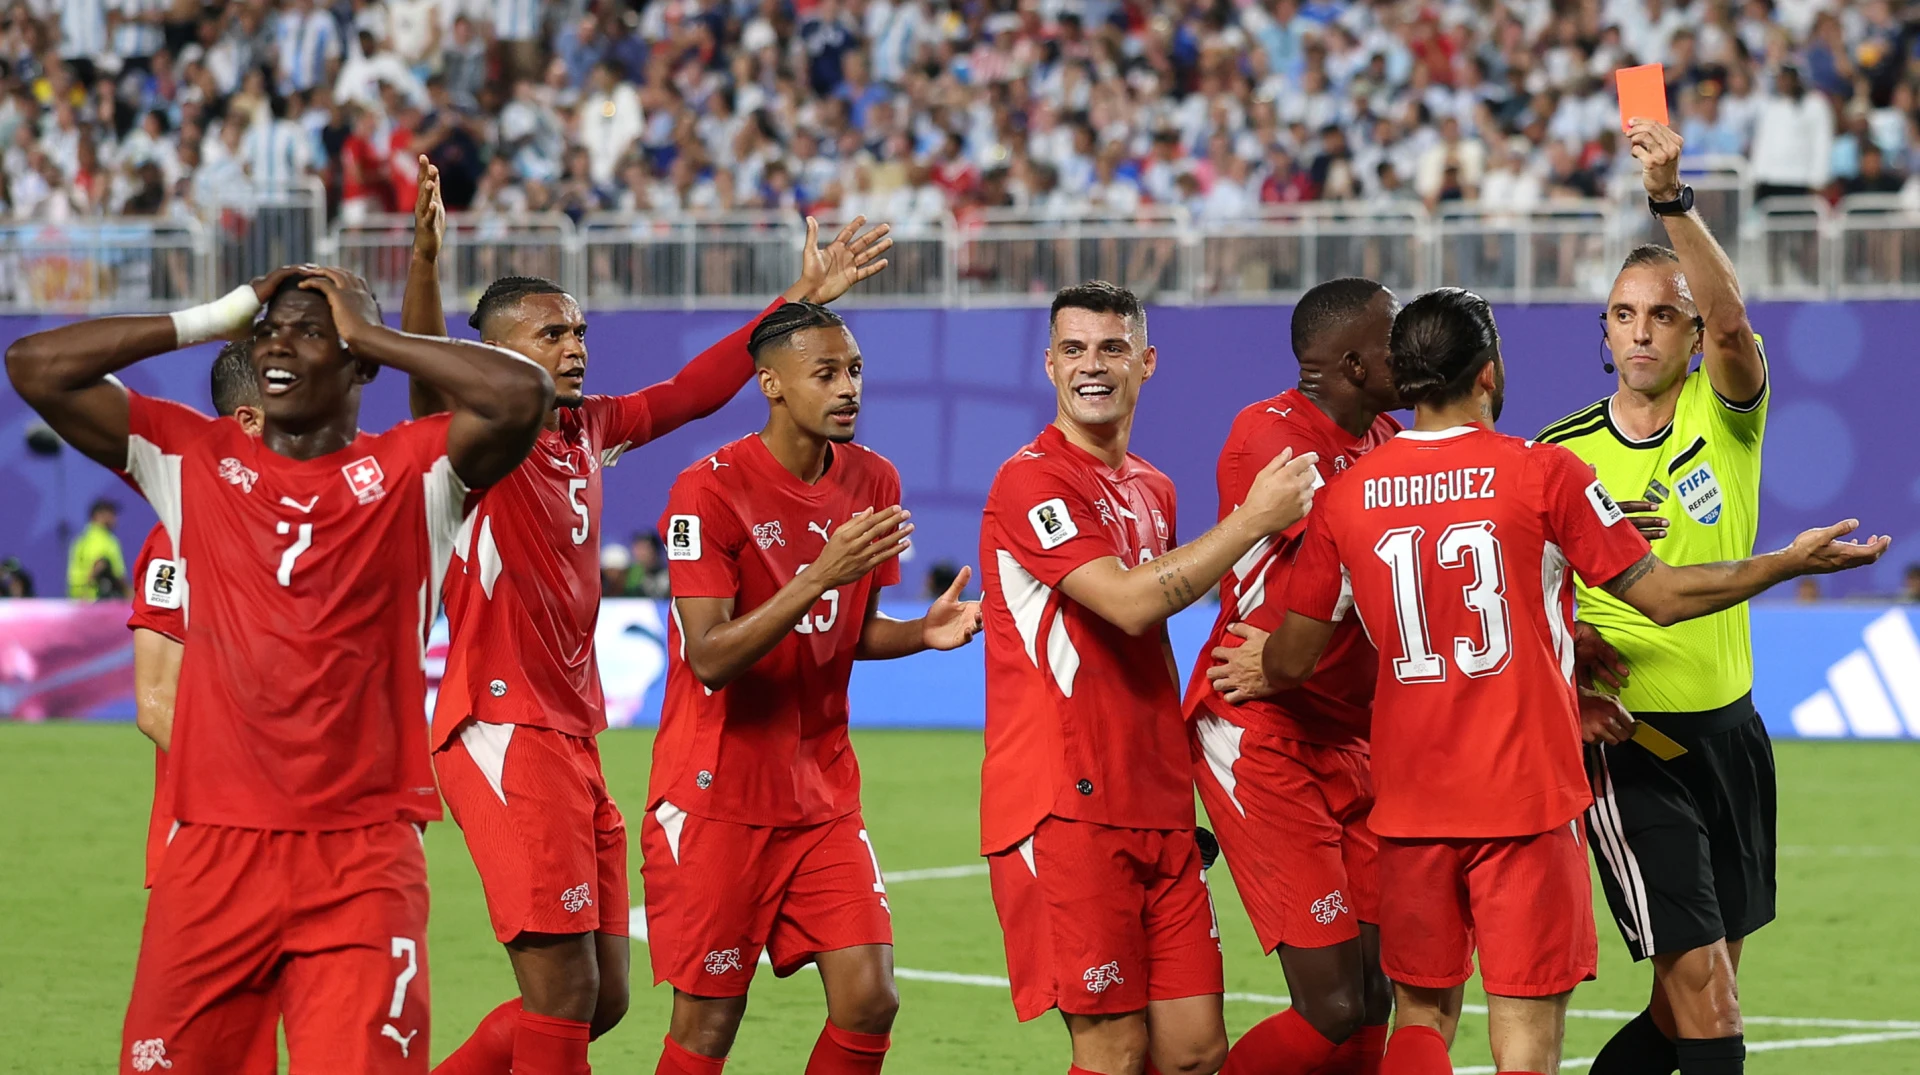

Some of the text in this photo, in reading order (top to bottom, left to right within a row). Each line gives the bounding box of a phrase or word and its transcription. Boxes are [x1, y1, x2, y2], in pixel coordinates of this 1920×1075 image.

[1364, 467, 1496, 510] RODRIGUEZ
[1678, 468, 1711, 497] FIFA
[1688, 486, 1718, 512] REFEREE
[568, 479, 589, 545] 5
[1704, 508, 1718, 523] 2026
[276, 520, 313, 587] 7
[1374, 520, 1512, 684] 13
[388, 936, 418, 1018] 7
